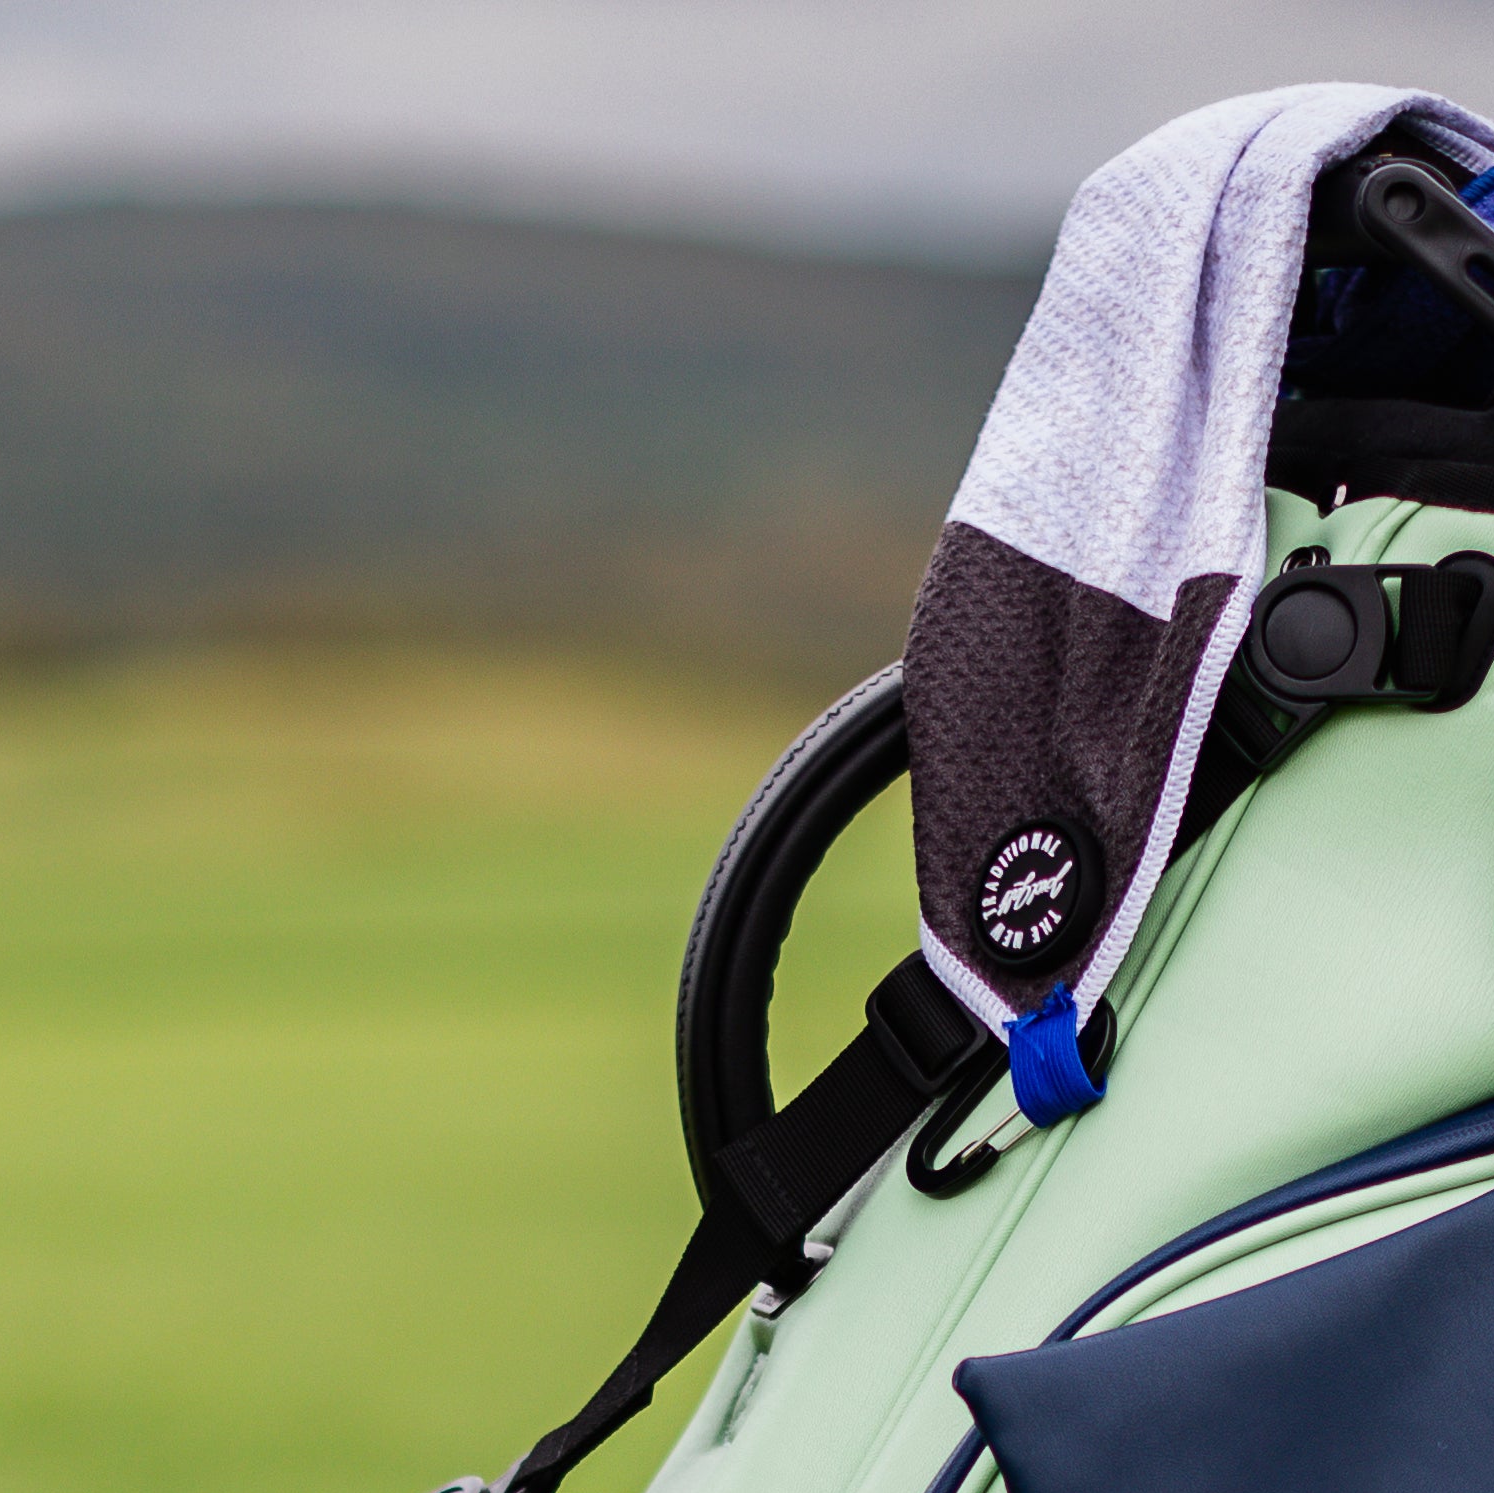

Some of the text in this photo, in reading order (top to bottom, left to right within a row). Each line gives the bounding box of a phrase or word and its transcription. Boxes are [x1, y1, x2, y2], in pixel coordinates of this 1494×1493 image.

[981, 832, 1062, 949] THE NEW TRADITIONAL
